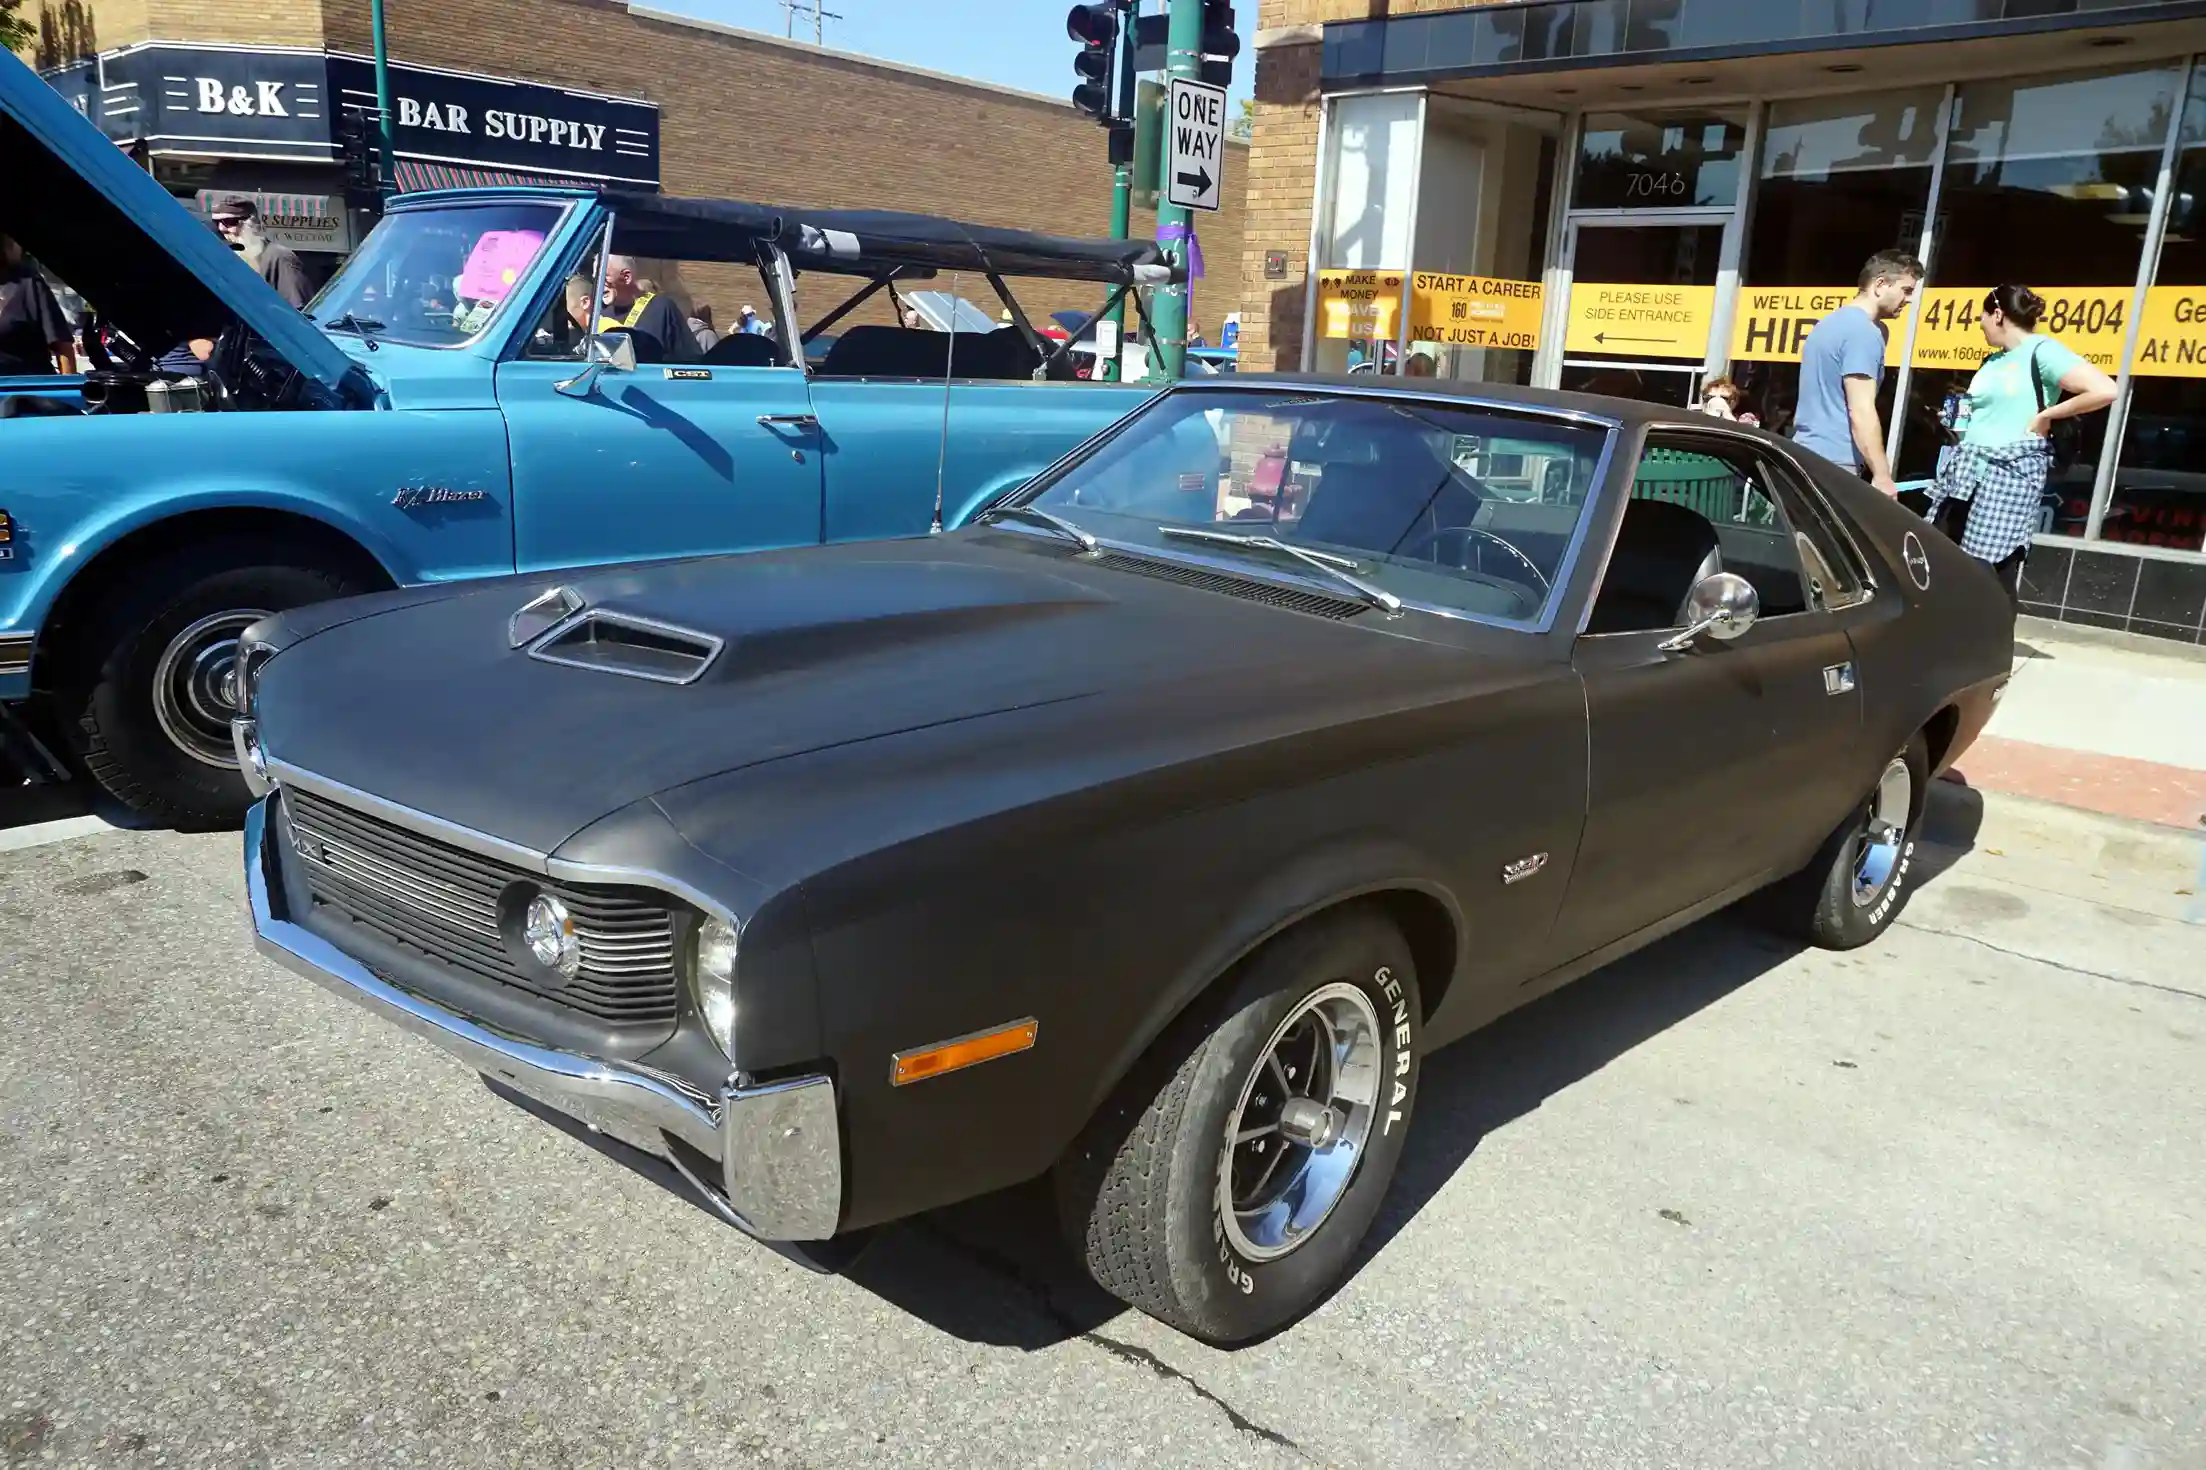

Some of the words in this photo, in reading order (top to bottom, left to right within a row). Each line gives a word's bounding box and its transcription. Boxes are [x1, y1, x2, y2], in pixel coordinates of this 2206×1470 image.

[195, 77, 289, 117] B&K
[1178, 91, 1219, 127] ONE
[397, 97, 471, 134] BAR
[485, 109, 606, 150] SUPPLY
[1178, 126, 1217, 160] WAY
[1626, 172, 1686, 197] 7046
[272, 214, 339, 228] SUPPLIES
[1345, 275, 1377, 285] MAKE
[1417, 275, 1464, 293] START
[1468, 278, 1478, 293] A
[1483, 280, 1541, 299] CAREER
[1340, 289, 1380, 300] MONEY
[1600, 292, 1650, 304] PLEASE
[1654, 293, 1683, 305] USE
[1753, 295, 1805, 310] WE'LL
[1810, 296, 1847, 310] GET
[1451, 302, 1467, 319] 160
[1585, 308, 1615, 320] SIDE
[1619, 309, 1693, 323] ENTRANCE
[1925, 298, 2124, 335] 414--8404
[1413, 326, 1445, 341] NOT
[1448, 328, 1485, 345] JUST
[1488, 331, 1499, 346] A
[1502, 332, 1535, 348] JOB!
[2140, 337, 2170, 363] At
[1374, 966, 1411, 1136] GENERAL
